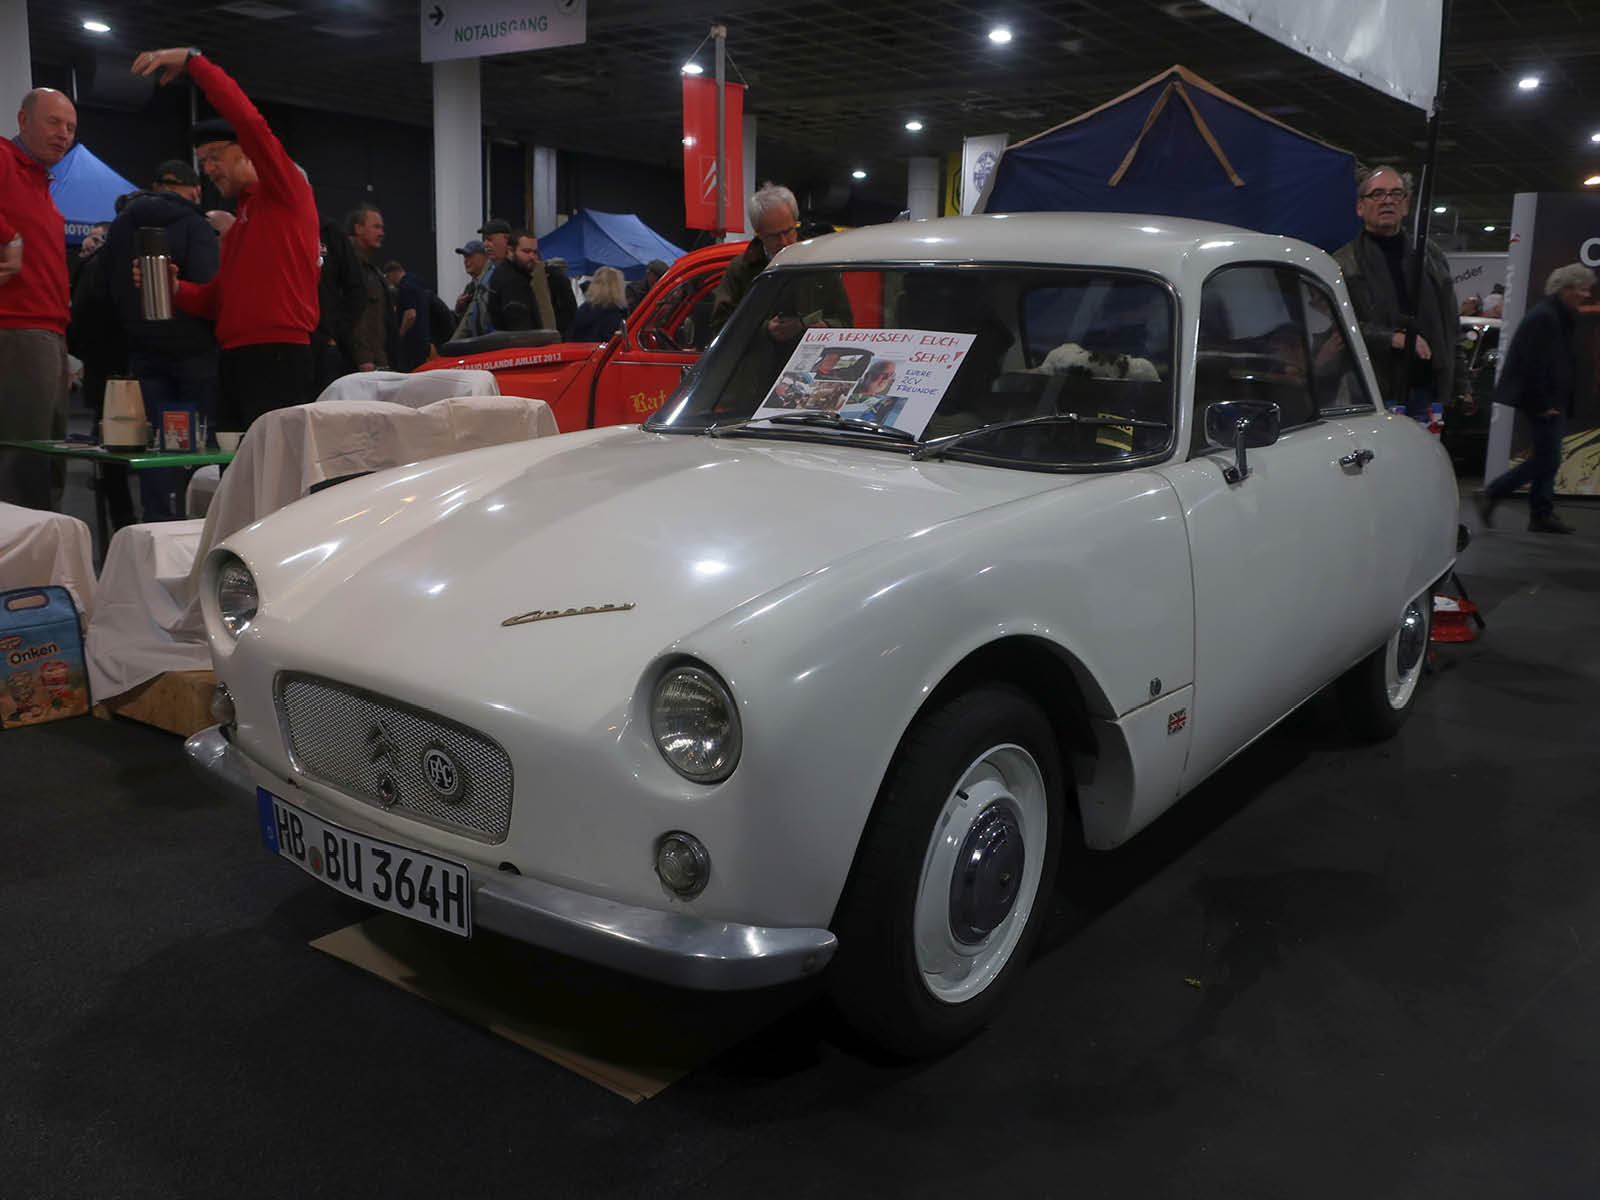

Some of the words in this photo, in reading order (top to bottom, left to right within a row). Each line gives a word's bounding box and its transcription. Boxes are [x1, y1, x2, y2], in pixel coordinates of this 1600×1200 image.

[455, 16, 549, 42] NOTAUSGANG
[805, 332, 832, 343] WIR
[839, 332, 915, 344] VERMISSEN
[920, 335, 961, 347] EUCH
[896, 384, 939, 396] FREUNDE
[11, 643, 57, 664] Onken
[275, 803, 306, 862] HB
[323, 830, 363, 893] BU
[371, 847, 466, 929] 364H
